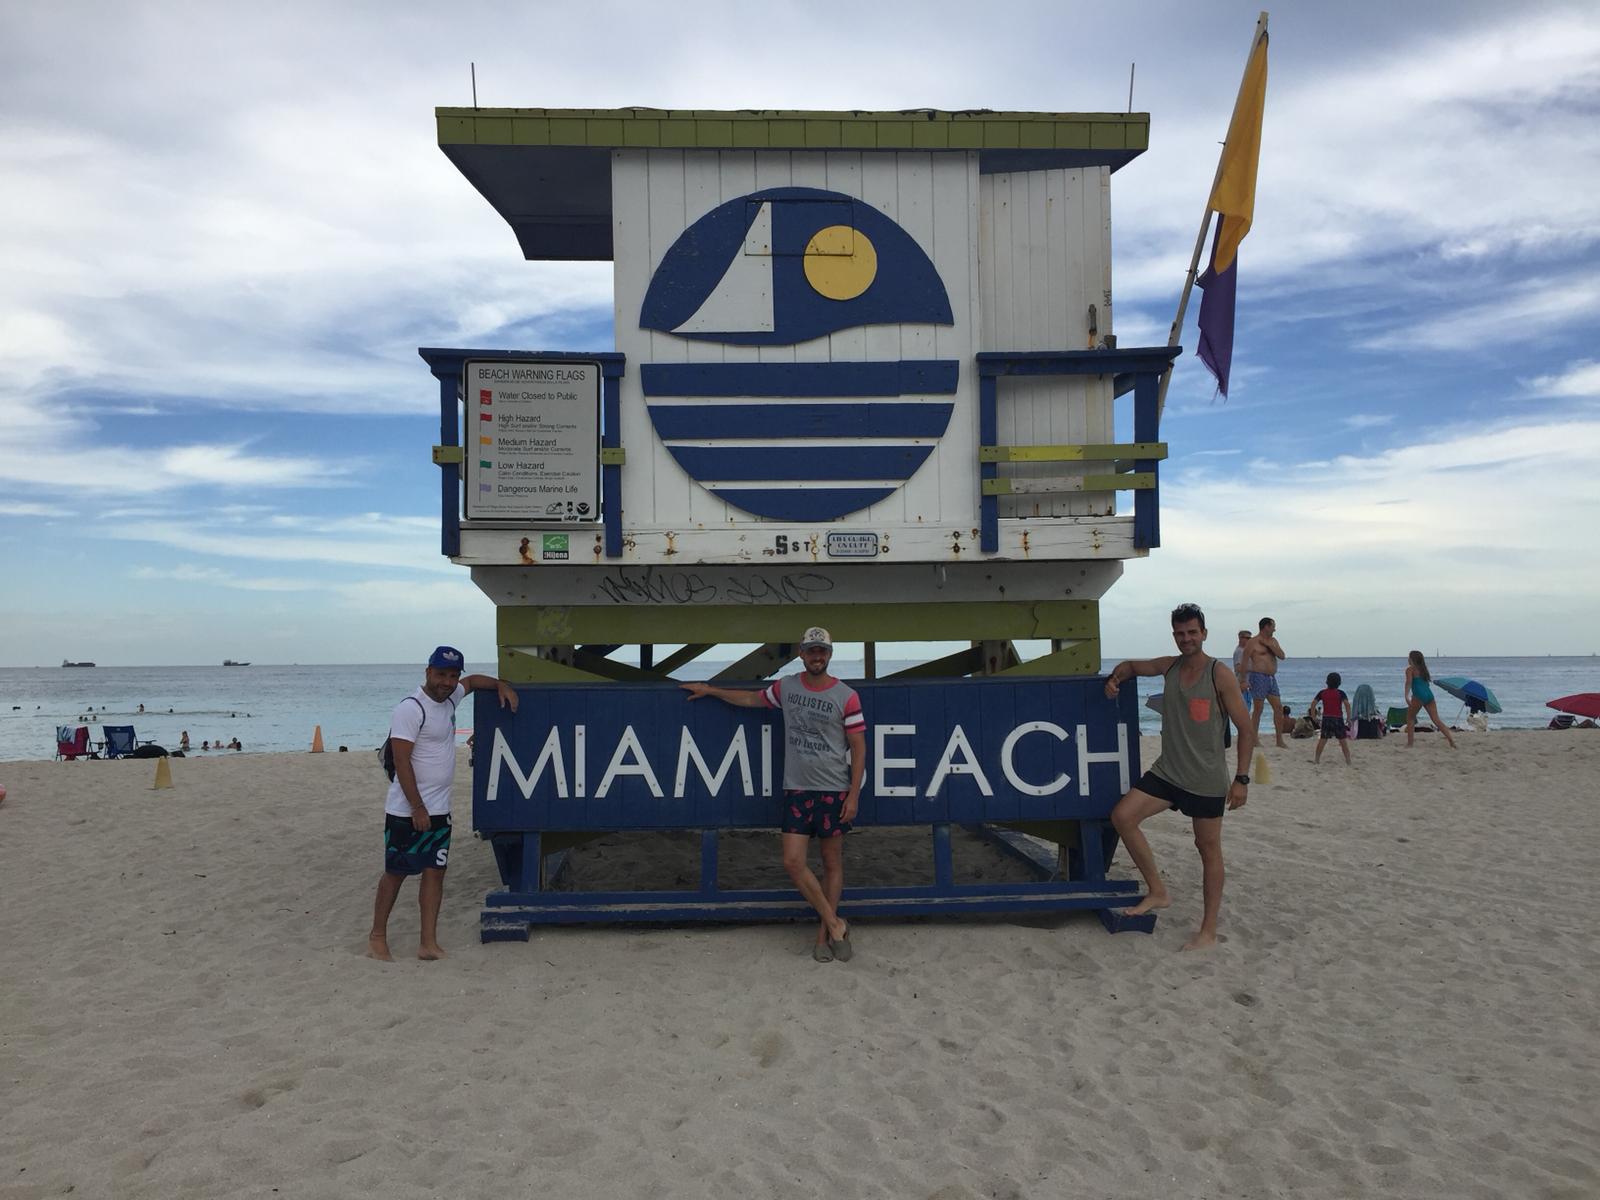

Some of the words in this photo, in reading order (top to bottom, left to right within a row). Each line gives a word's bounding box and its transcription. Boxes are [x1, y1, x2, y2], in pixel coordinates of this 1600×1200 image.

[479, 368, 510, 379] BEACH
[512, 369, 554, 380] WARNING
[556, 370, 585, 380] FLAGS
[499, 392, 519, 400] Water
[521, 392, 546, 400] Closed
[557, 392, 578, 401] Public
[498, 414, 514, 425] High
[516, 415, 541, 423] Hazard
[498, 438, 527, 446] Medium
[529, 439, 557, 447] Hazard
[498, 462, 515, 470] Low
[516, 462, 545, 470] Hazard
[498, 485, 537, 495] Dangerous
[539, 485, 563, 493] Marine
[565, 485, 578, 493] Life
[787, 692, 833, 713] HOLLISTER
[486, 724, 772, 801] MIAMI
[846, 719, 1131, 797] EACH
